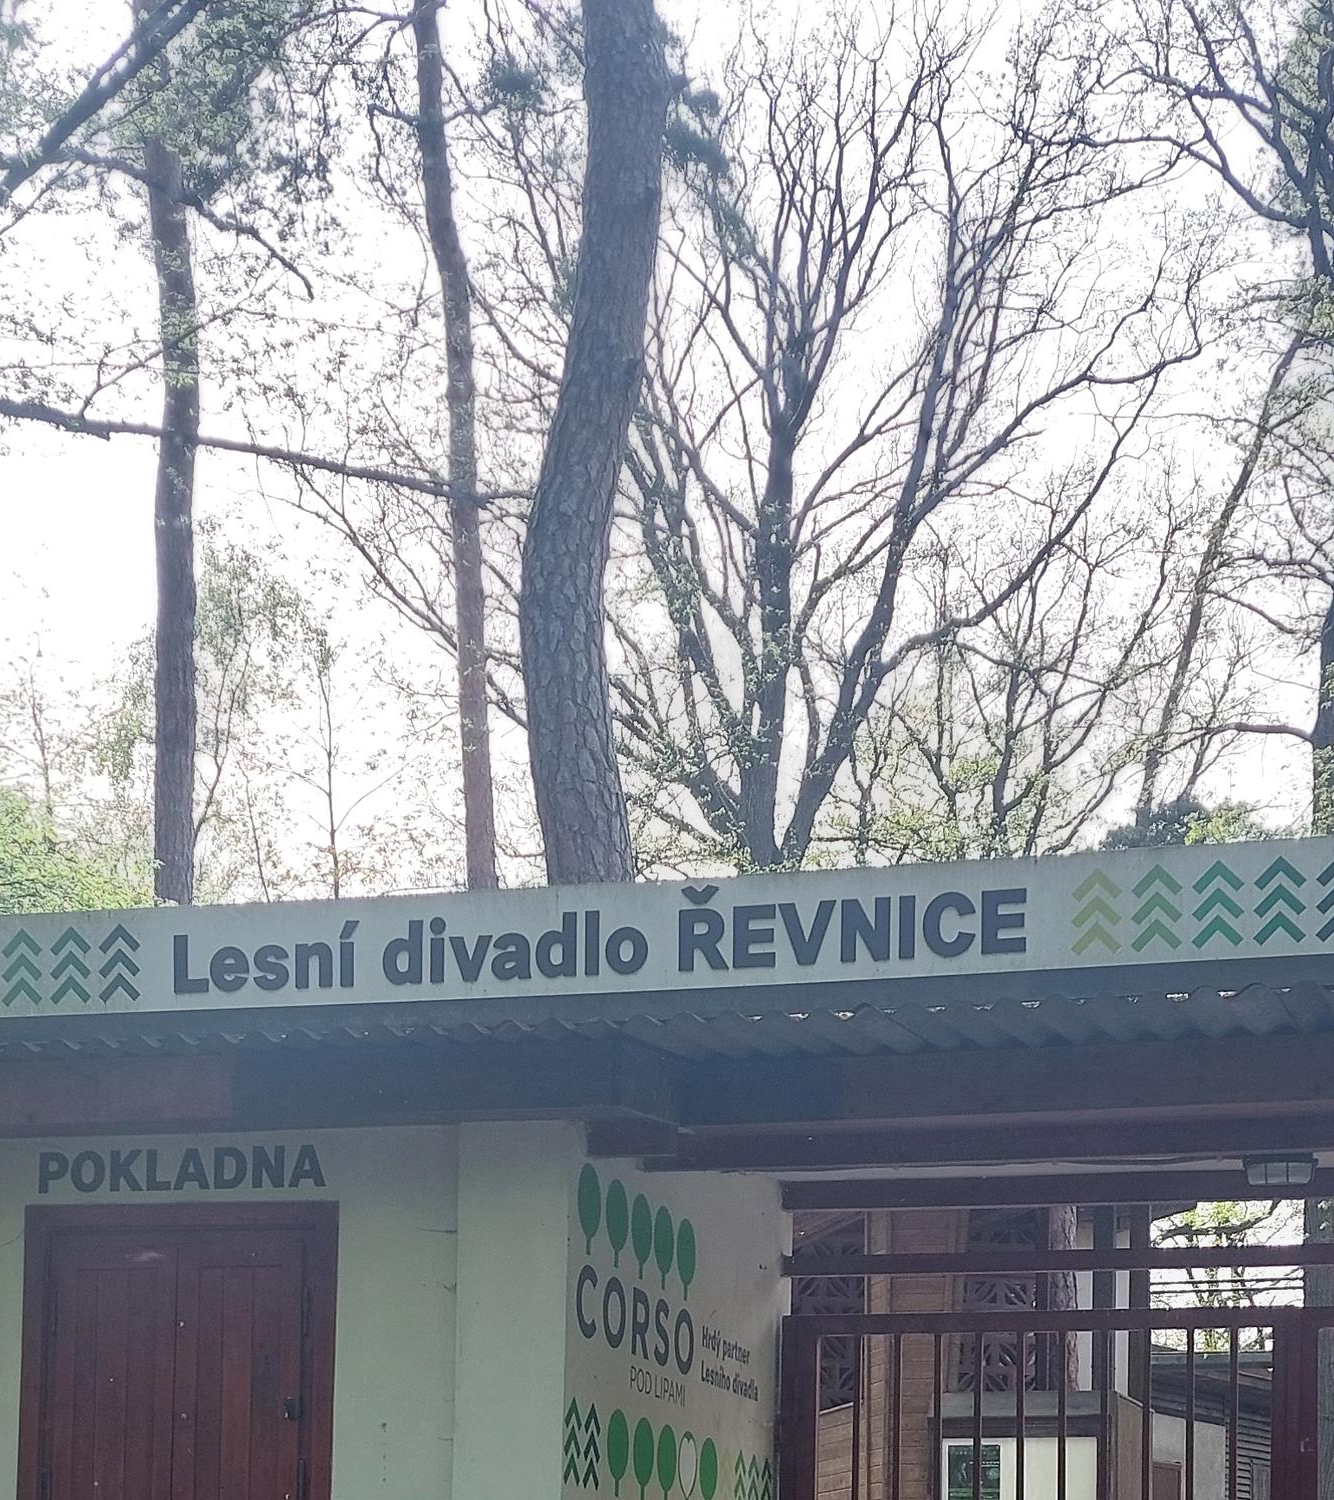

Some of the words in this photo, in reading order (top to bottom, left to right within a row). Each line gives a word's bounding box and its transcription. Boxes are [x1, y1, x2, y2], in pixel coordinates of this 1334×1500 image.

[173, 920, 361, 995] Lesní
[382, 910, 649, 987] divadlo
[676, 884, 1028, 975] ŘEVNICE
[37, 1145, 326, 1195] POKLADNA
[576, 1264, 695, 1376] CORSO
[701, 1325, 721, 1359] Hrdý
[722, 1338, 751, 1365] partner
[629, 1365, 653, 1395] POD
[654, 1375, 686, 1407] LIPAMI
[700, 1360, 731, 1391] Lesního
[732, 1373, 759, 1401] divadla
